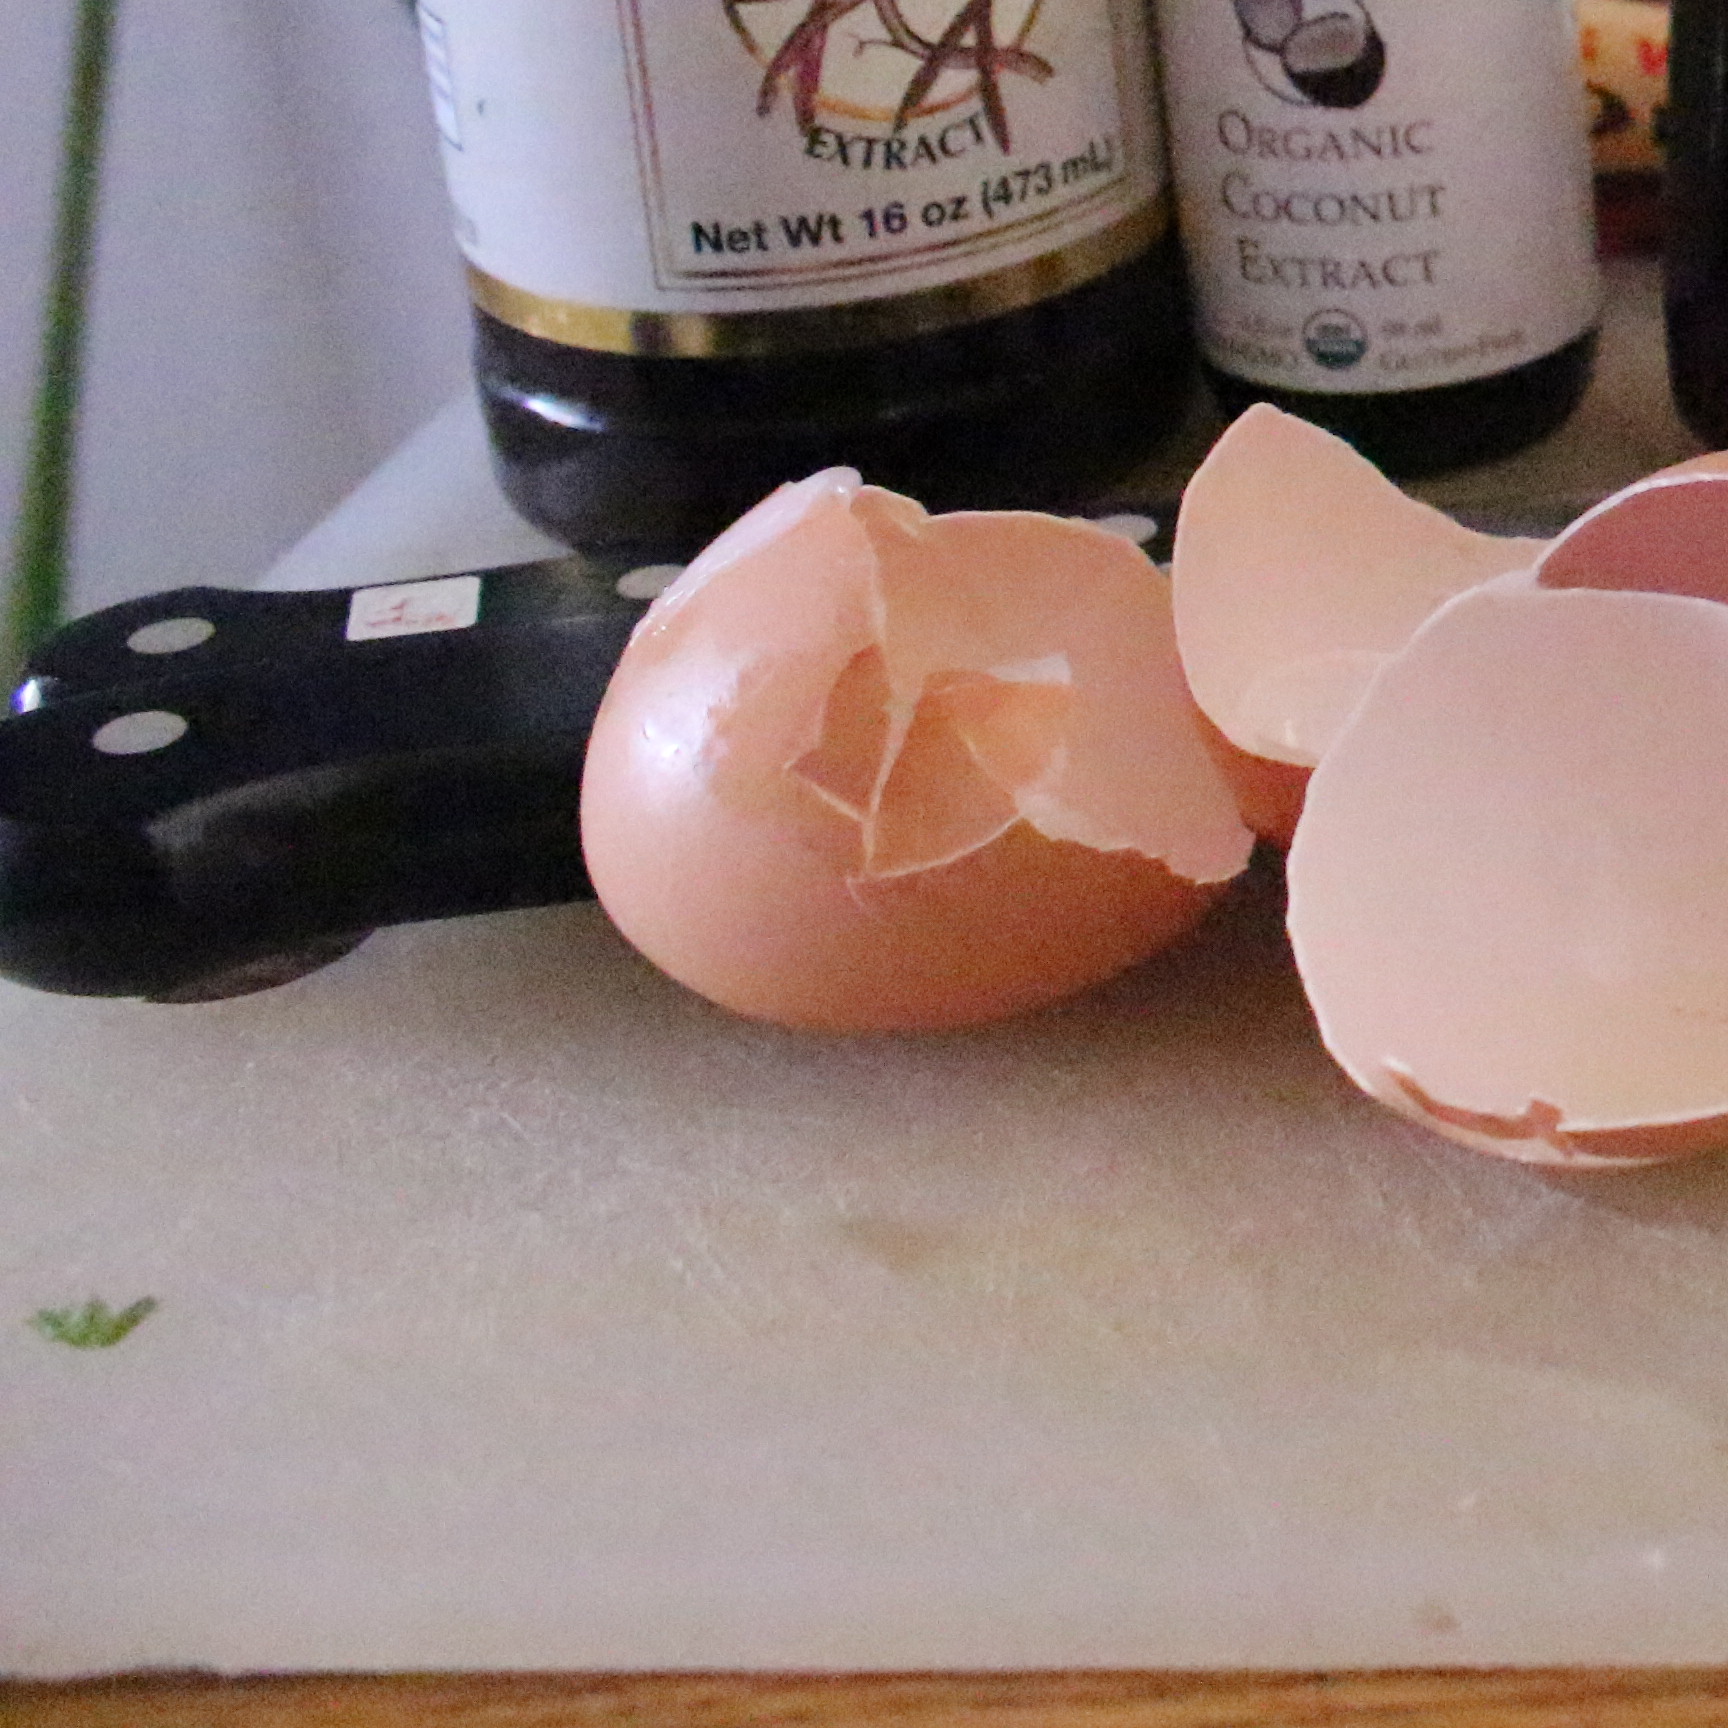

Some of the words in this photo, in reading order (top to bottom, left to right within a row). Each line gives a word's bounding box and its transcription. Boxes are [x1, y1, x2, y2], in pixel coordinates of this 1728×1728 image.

[802, 110, 988, 171] EXTRACT
[1217, 109, 1435, 163] ORGANIC
[690, 219, 770, 254] Net
[780, 211, 843, 248] Wt
[860, 202, 909, 240] 16
[921, 194, 968, 229] oz
[980, 165, 1055, 220] (473
[1221, 171, 1446, 227] COCONUT
[1237, 236, 1442, 292] EXTRACT
